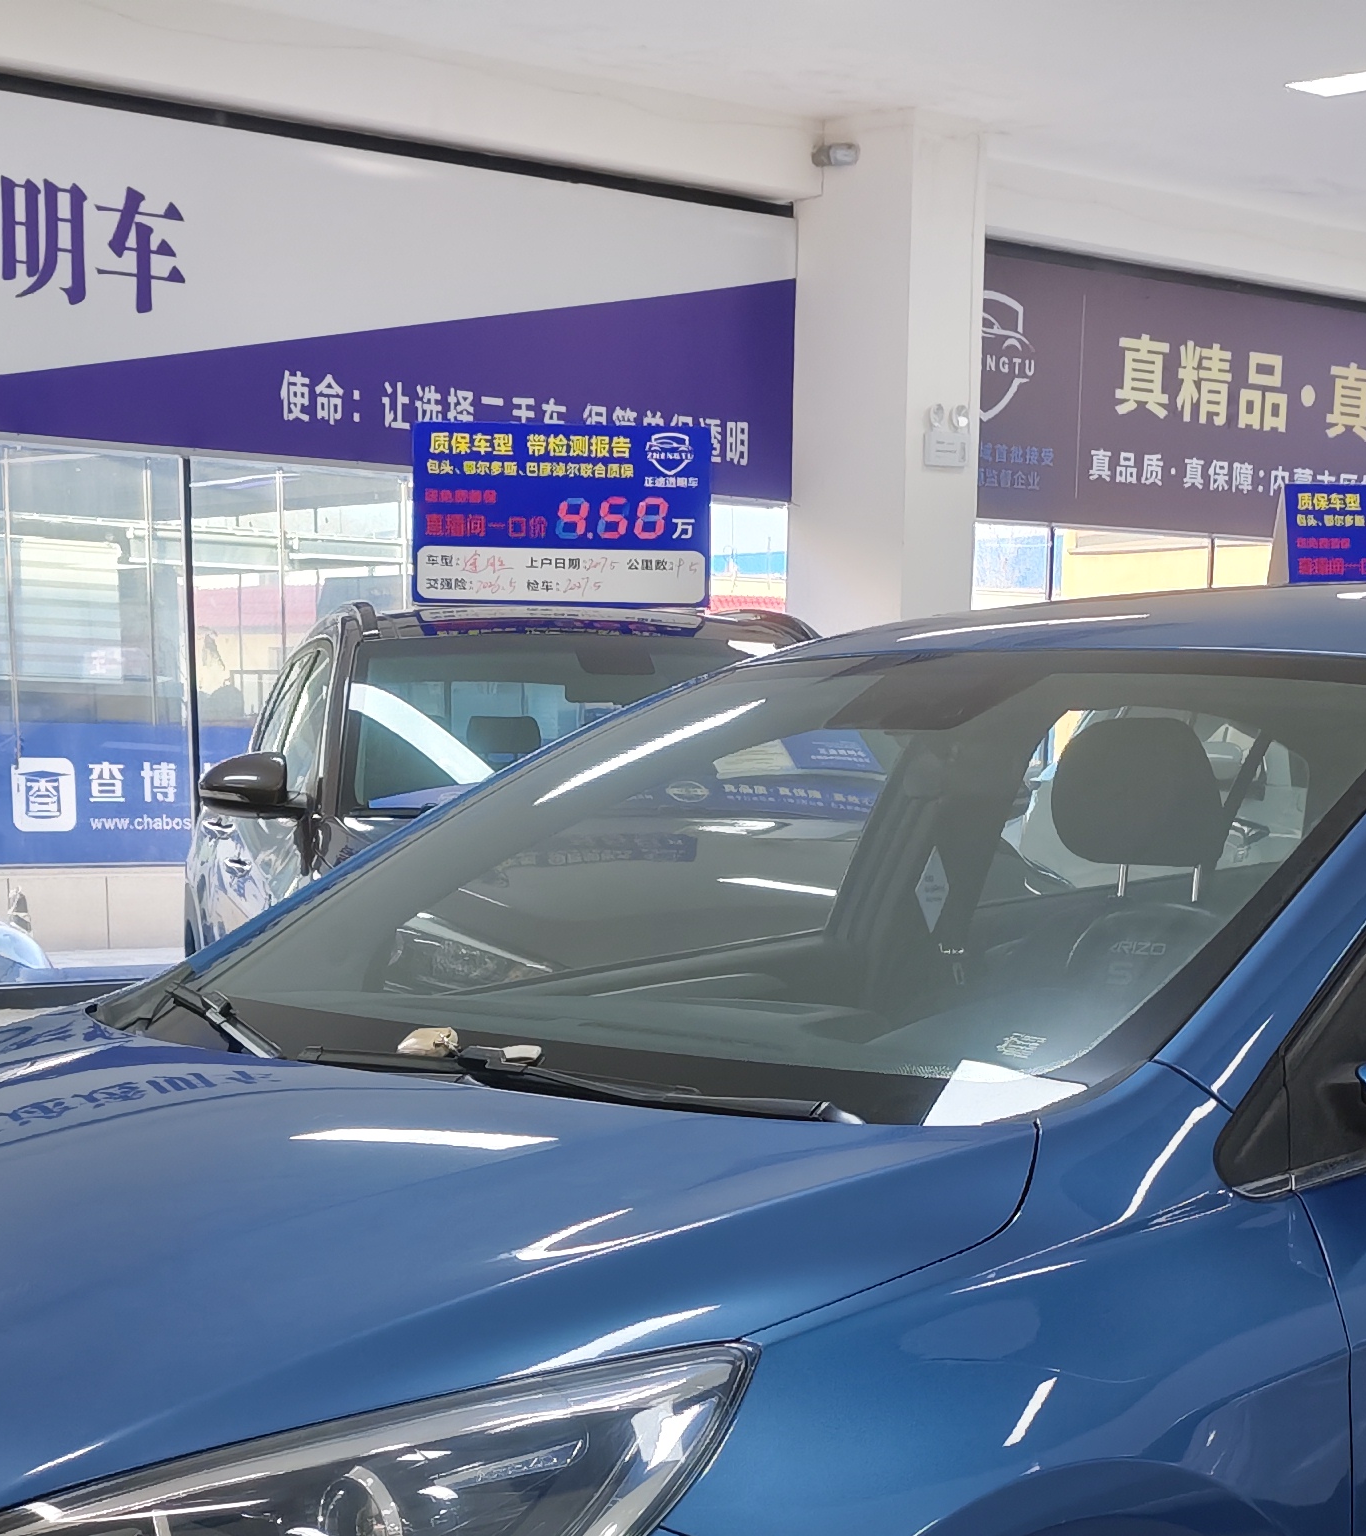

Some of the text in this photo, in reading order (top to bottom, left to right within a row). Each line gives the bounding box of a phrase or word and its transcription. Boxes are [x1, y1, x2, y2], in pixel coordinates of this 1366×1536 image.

[981, 354, 1036, 376] NGTU
[429, 431, 632, 458] 质保车型 带检测报告
[1297, 492, 1361, 511] 质保车型
[671, 518, 696, 539] 万
